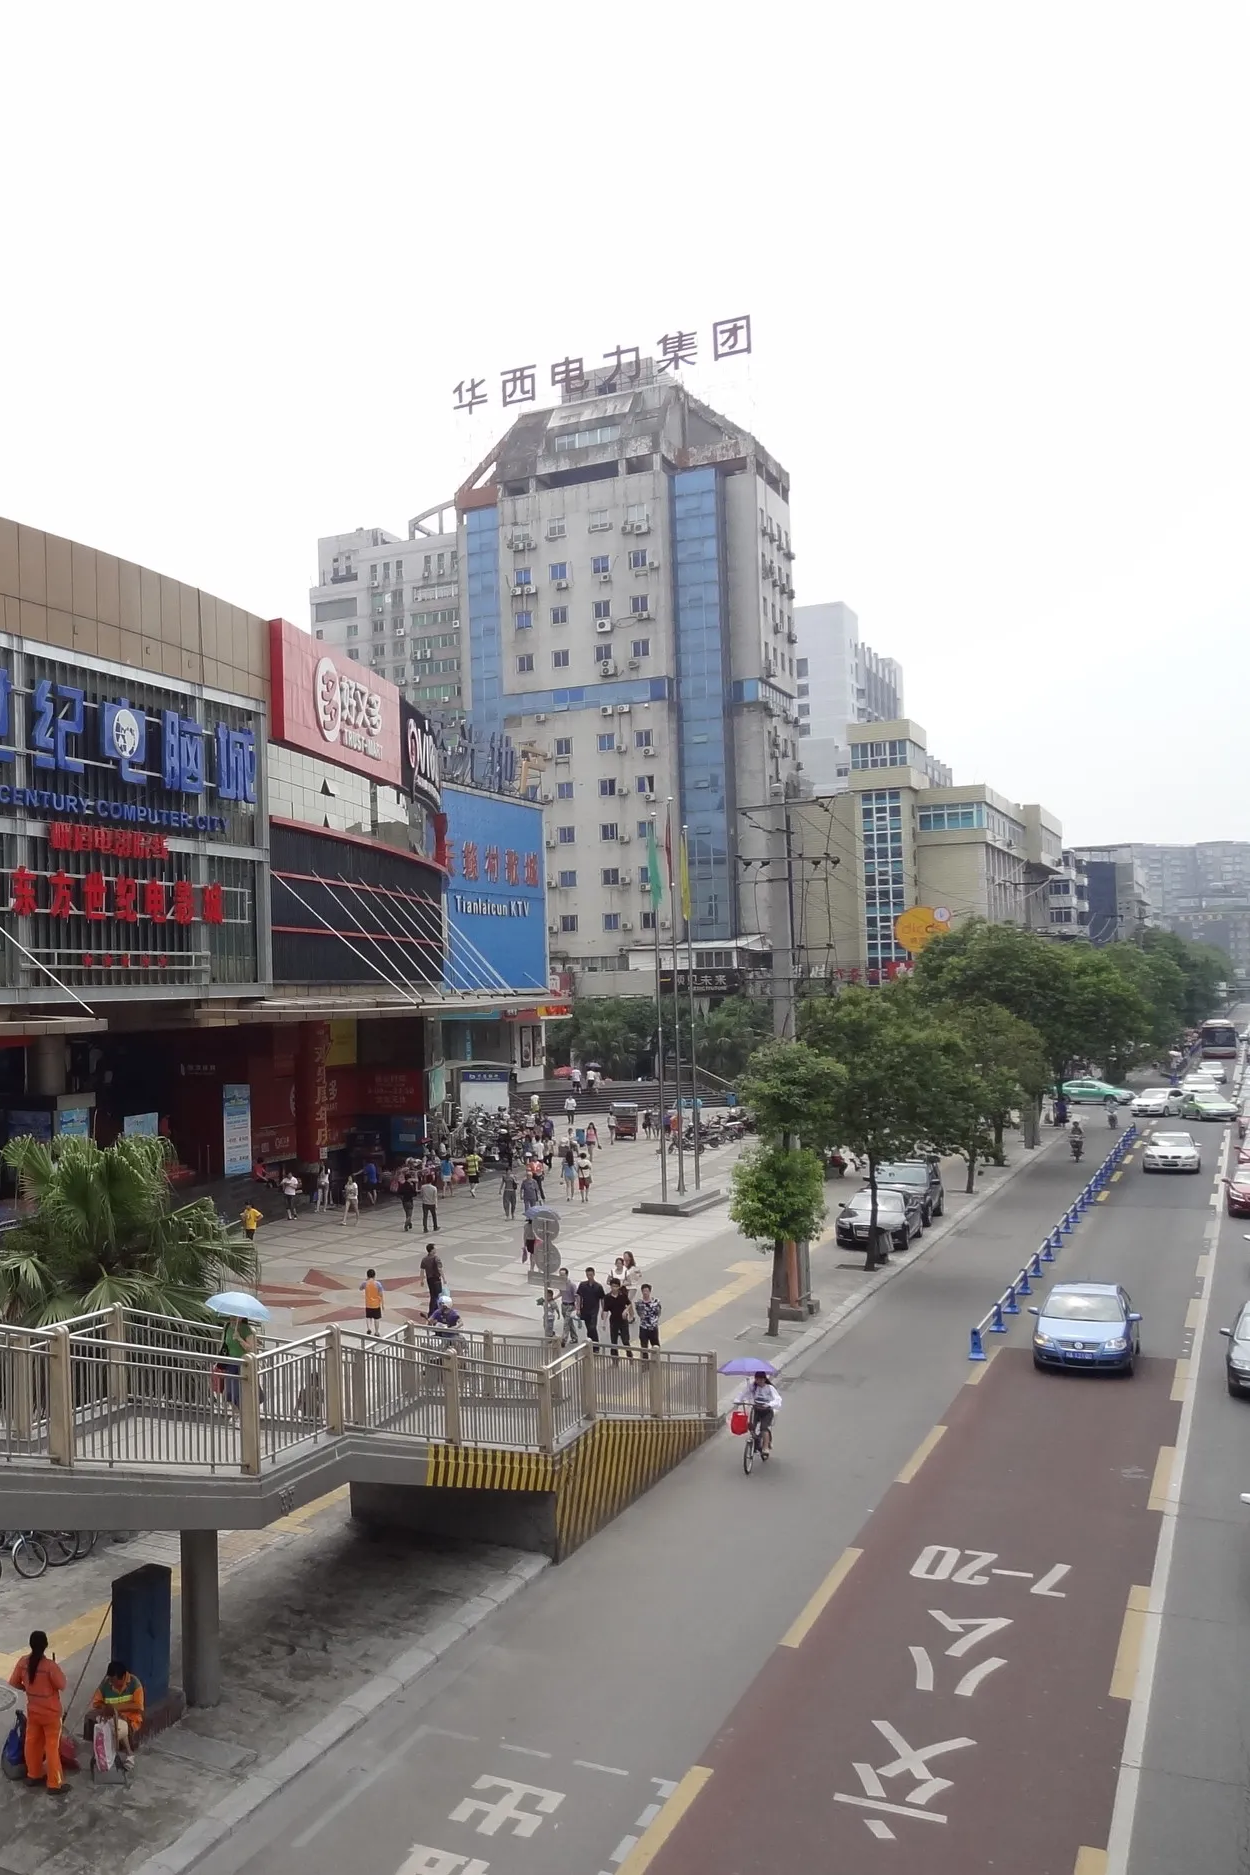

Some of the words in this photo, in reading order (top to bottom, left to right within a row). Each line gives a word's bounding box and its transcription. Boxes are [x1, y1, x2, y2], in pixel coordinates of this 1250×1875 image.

[452, 314, 752, 414] 华西电力集团
[339, 675, 383, 737] 好又多
[341, 728, 383, 761] TRUST-MART
[96, 798, 193, 828] COMPUTER
[195, 811, 231, 833] CITY
[11, 865, 225, 925] 东方世纪电影城
[454, 894, 508, 916] Tianlaicun
[510, 900, 530, 917] KTV
